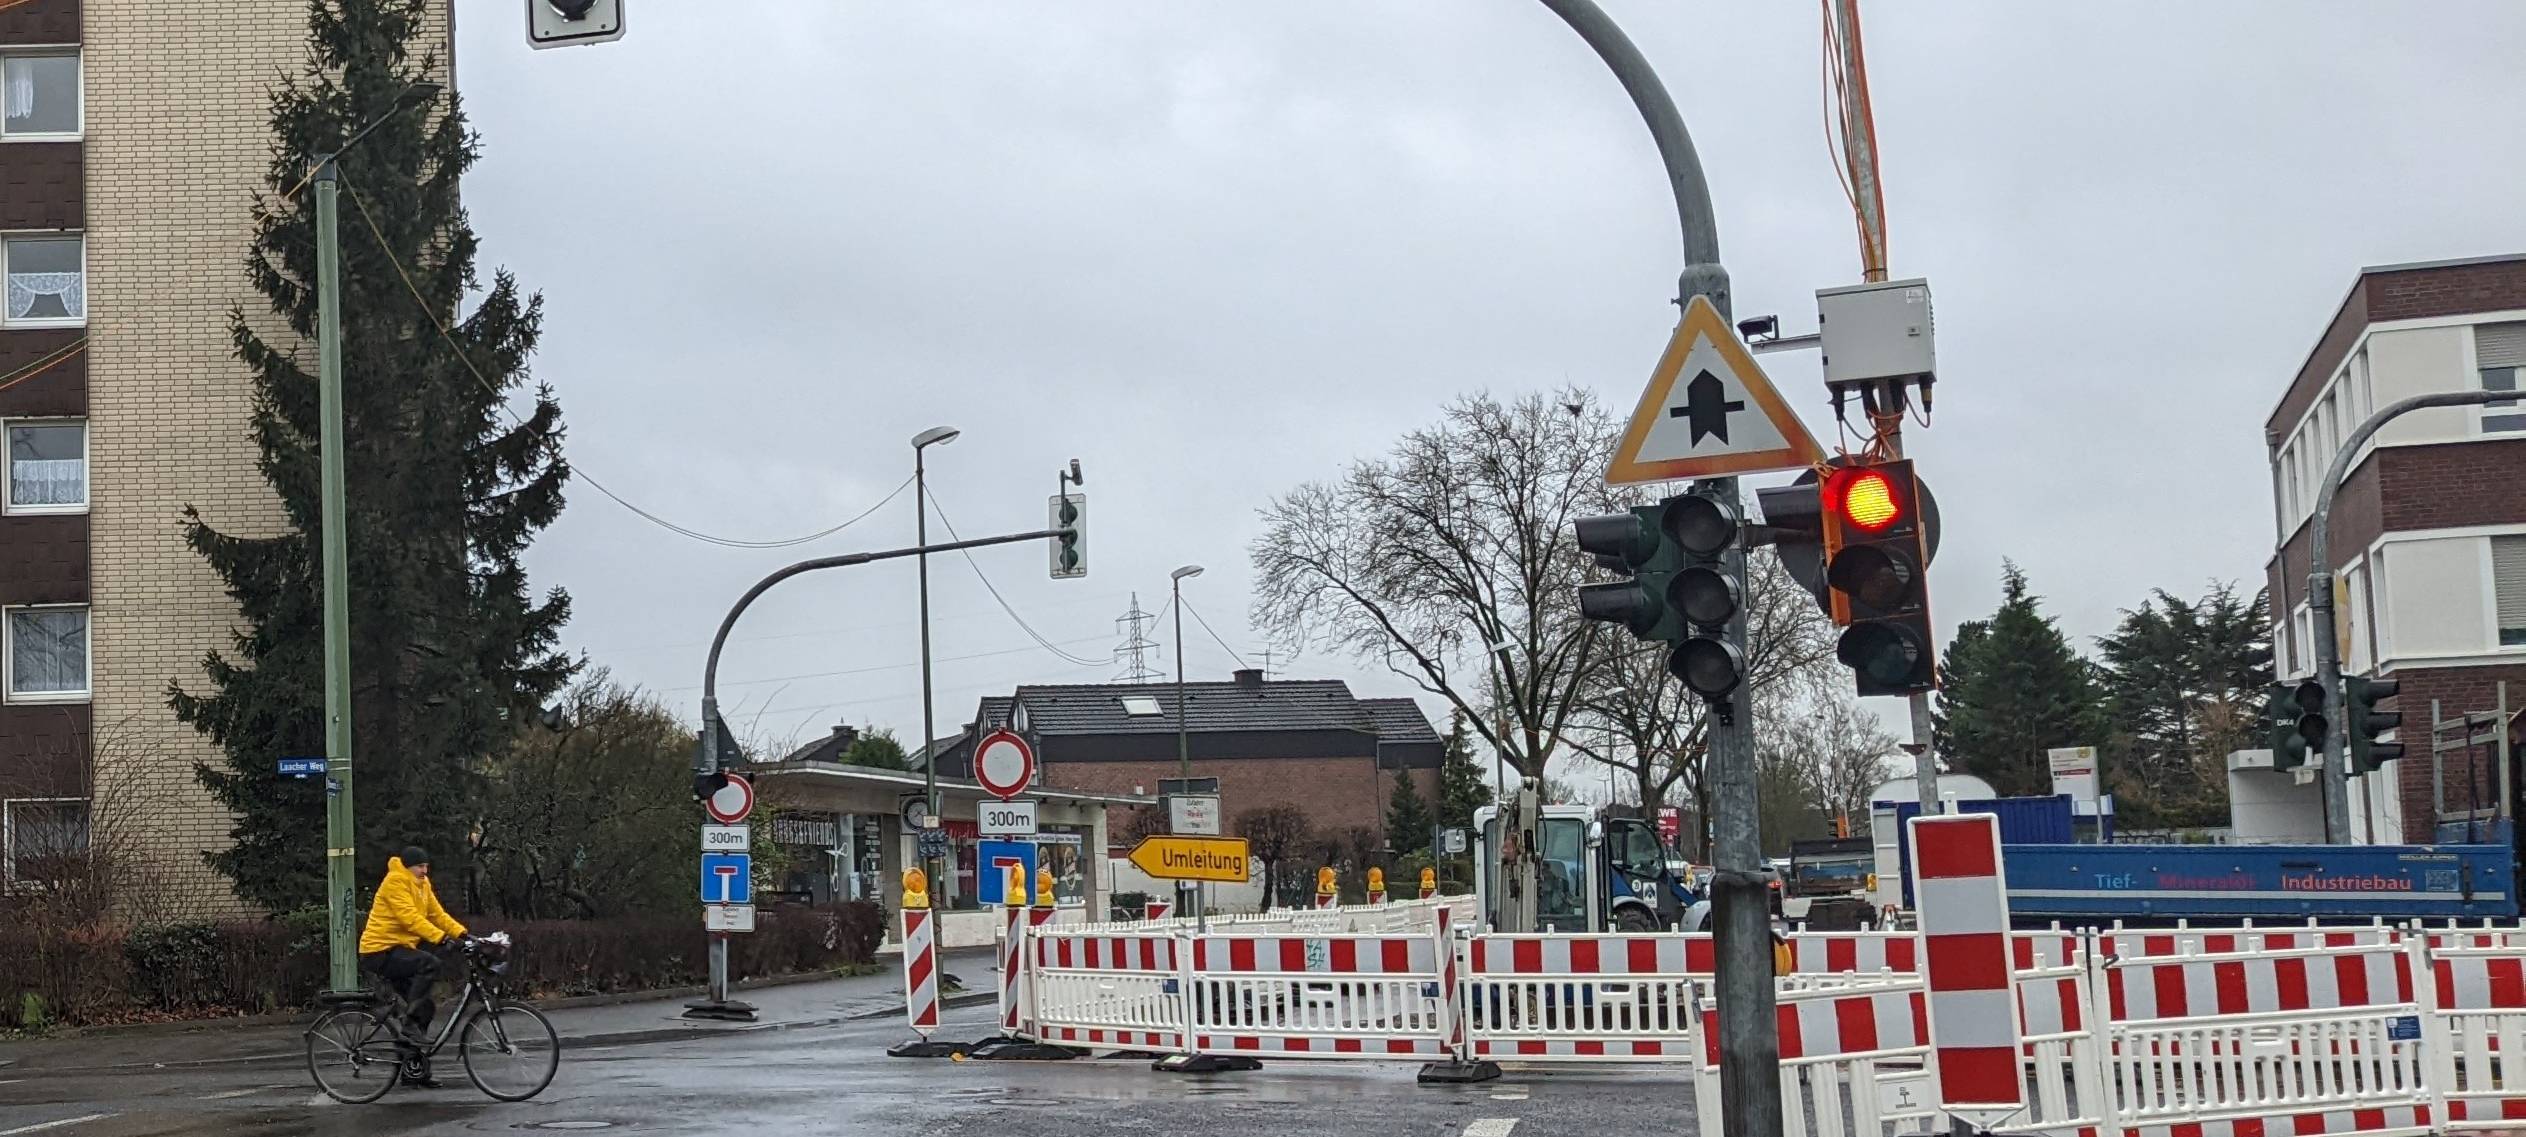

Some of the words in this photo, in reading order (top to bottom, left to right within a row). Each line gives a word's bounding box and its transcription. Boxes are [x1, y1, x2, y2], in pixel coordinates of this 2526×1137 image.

[2276, 718, 2295, 727] DK4
[988, 811, 1030, 827] 300m
[708, 832, 743, 844] 300m
[1162, 848, 1242, 875] Umleitung
[2094, 873, 2138, 889] Tief-
[2282, 873, 2412, 890] Industriebau
